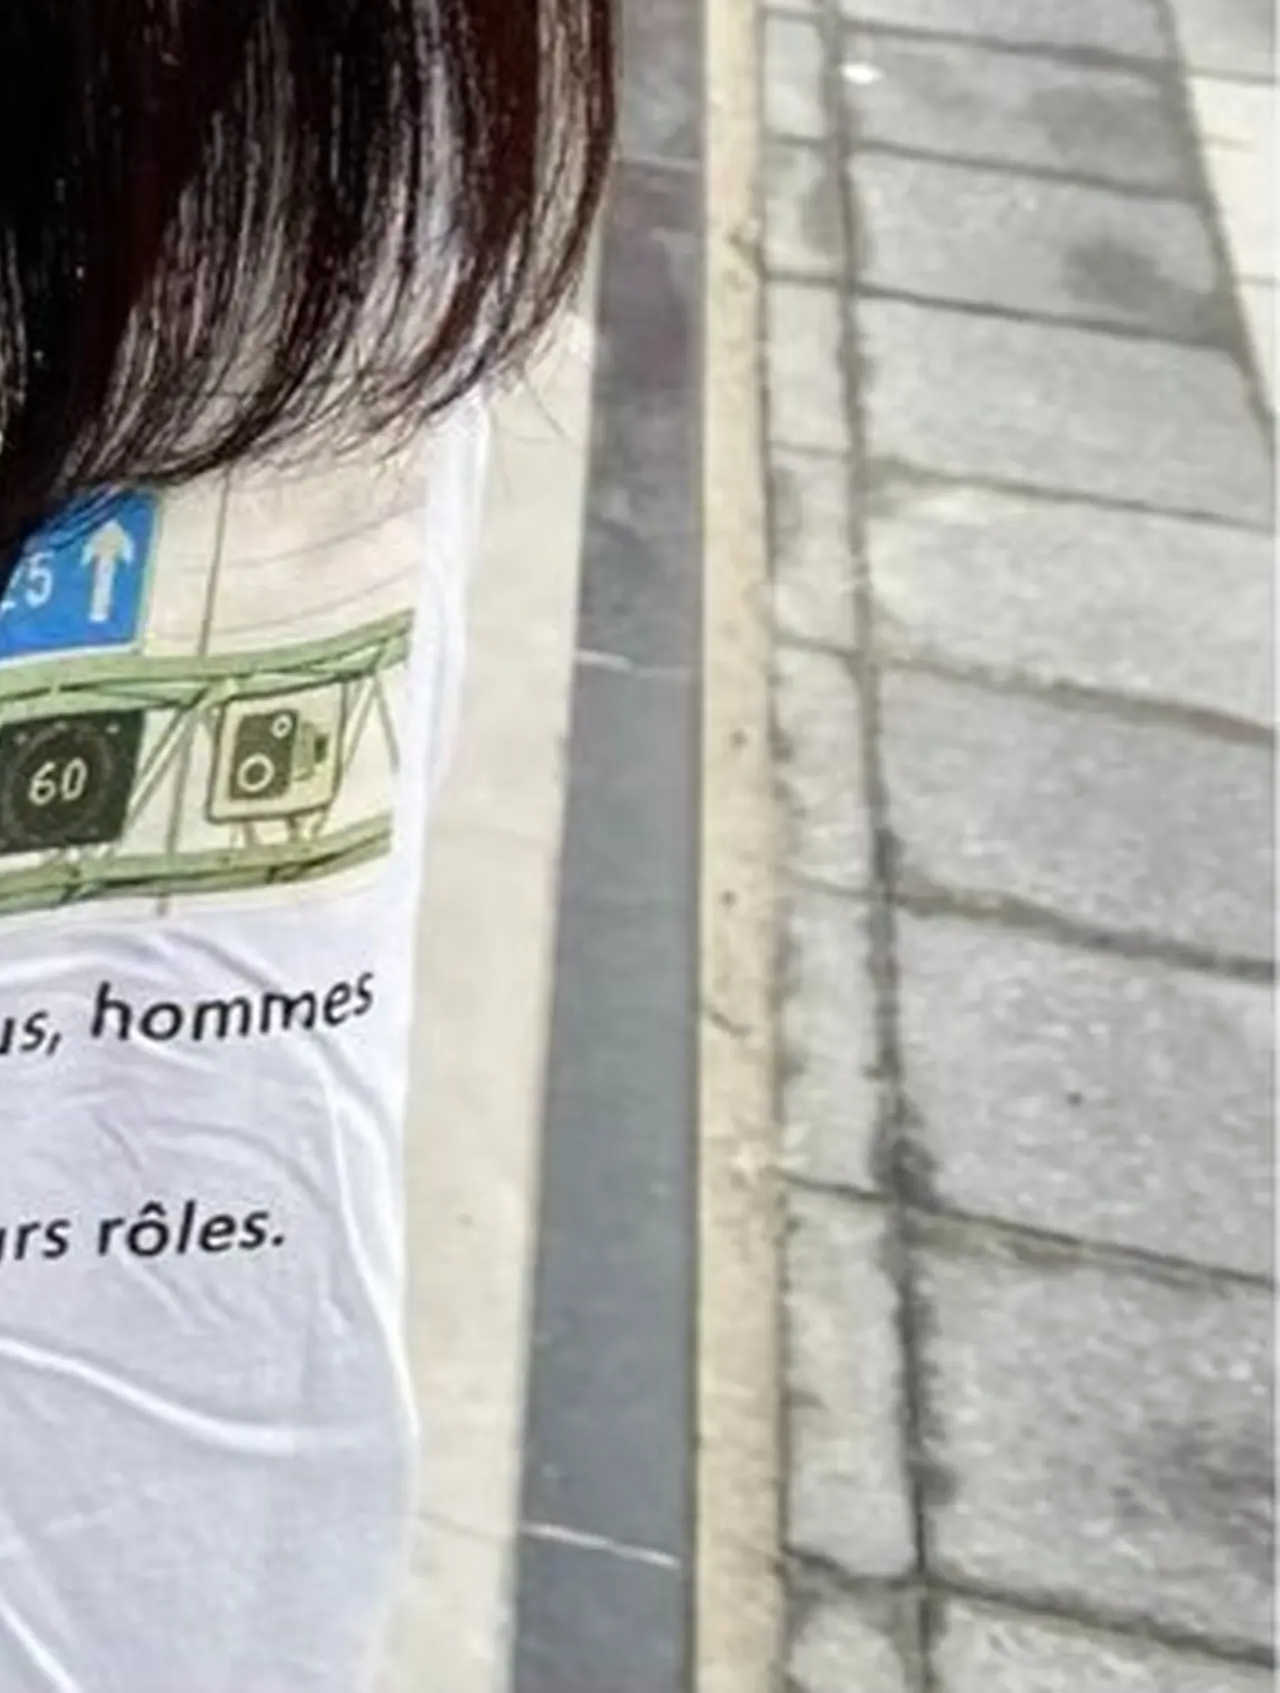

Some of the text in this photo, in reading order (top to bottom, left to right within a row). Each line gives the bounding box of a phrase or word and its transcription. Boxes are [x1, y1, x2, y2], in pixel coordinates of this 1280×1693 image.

[27, 757, 89, 808] 60
[90, 971, 374, 1043] hommes
[97, 1198, 287, 1260] rôles.
